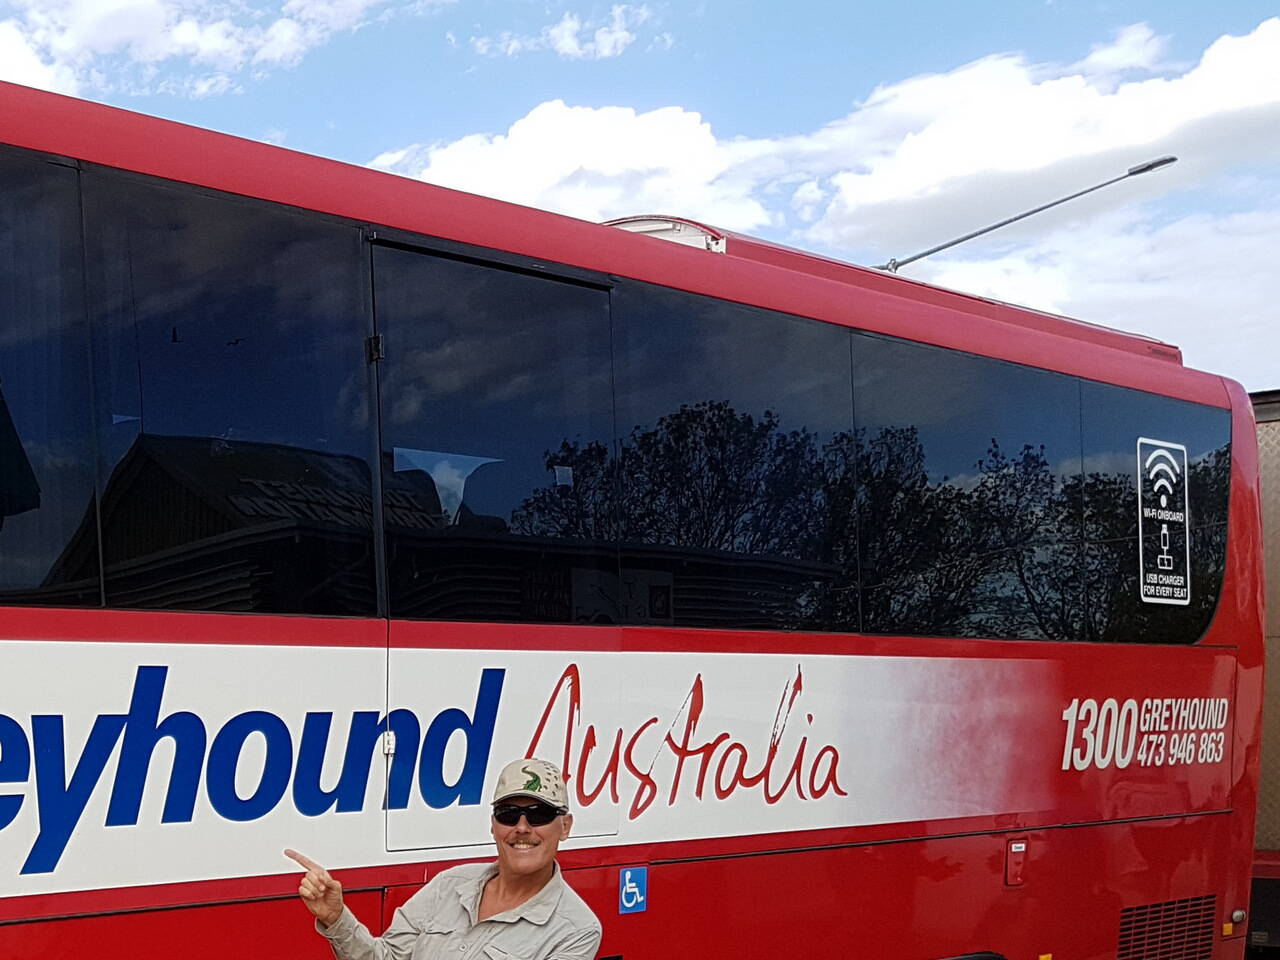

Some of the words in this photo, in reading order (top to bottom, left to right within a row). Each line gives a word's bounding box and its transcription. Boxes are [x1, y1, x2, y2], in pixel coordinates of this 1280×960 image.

[1157, 510, 1184, 522] ONBOARD
[1143, 585, 1155, 596] FOR
[1156, 586, 1173, 597] EVERY
[1173, 588, 1187, 598] SEAT
[1146, 573, 1157, 584] USB
[1158, 575, 1184, 586] CHARGER
[525, 663, 848, 820] Australia
[1061, 698, 1138, 771] 1300
[1140, 698, 1228, 732] GREYHOUND
[1137, 734, 1166, 767] 473
[1168, 733, 1196, 766] 946
[1198, 732, 1225, 764] 863
